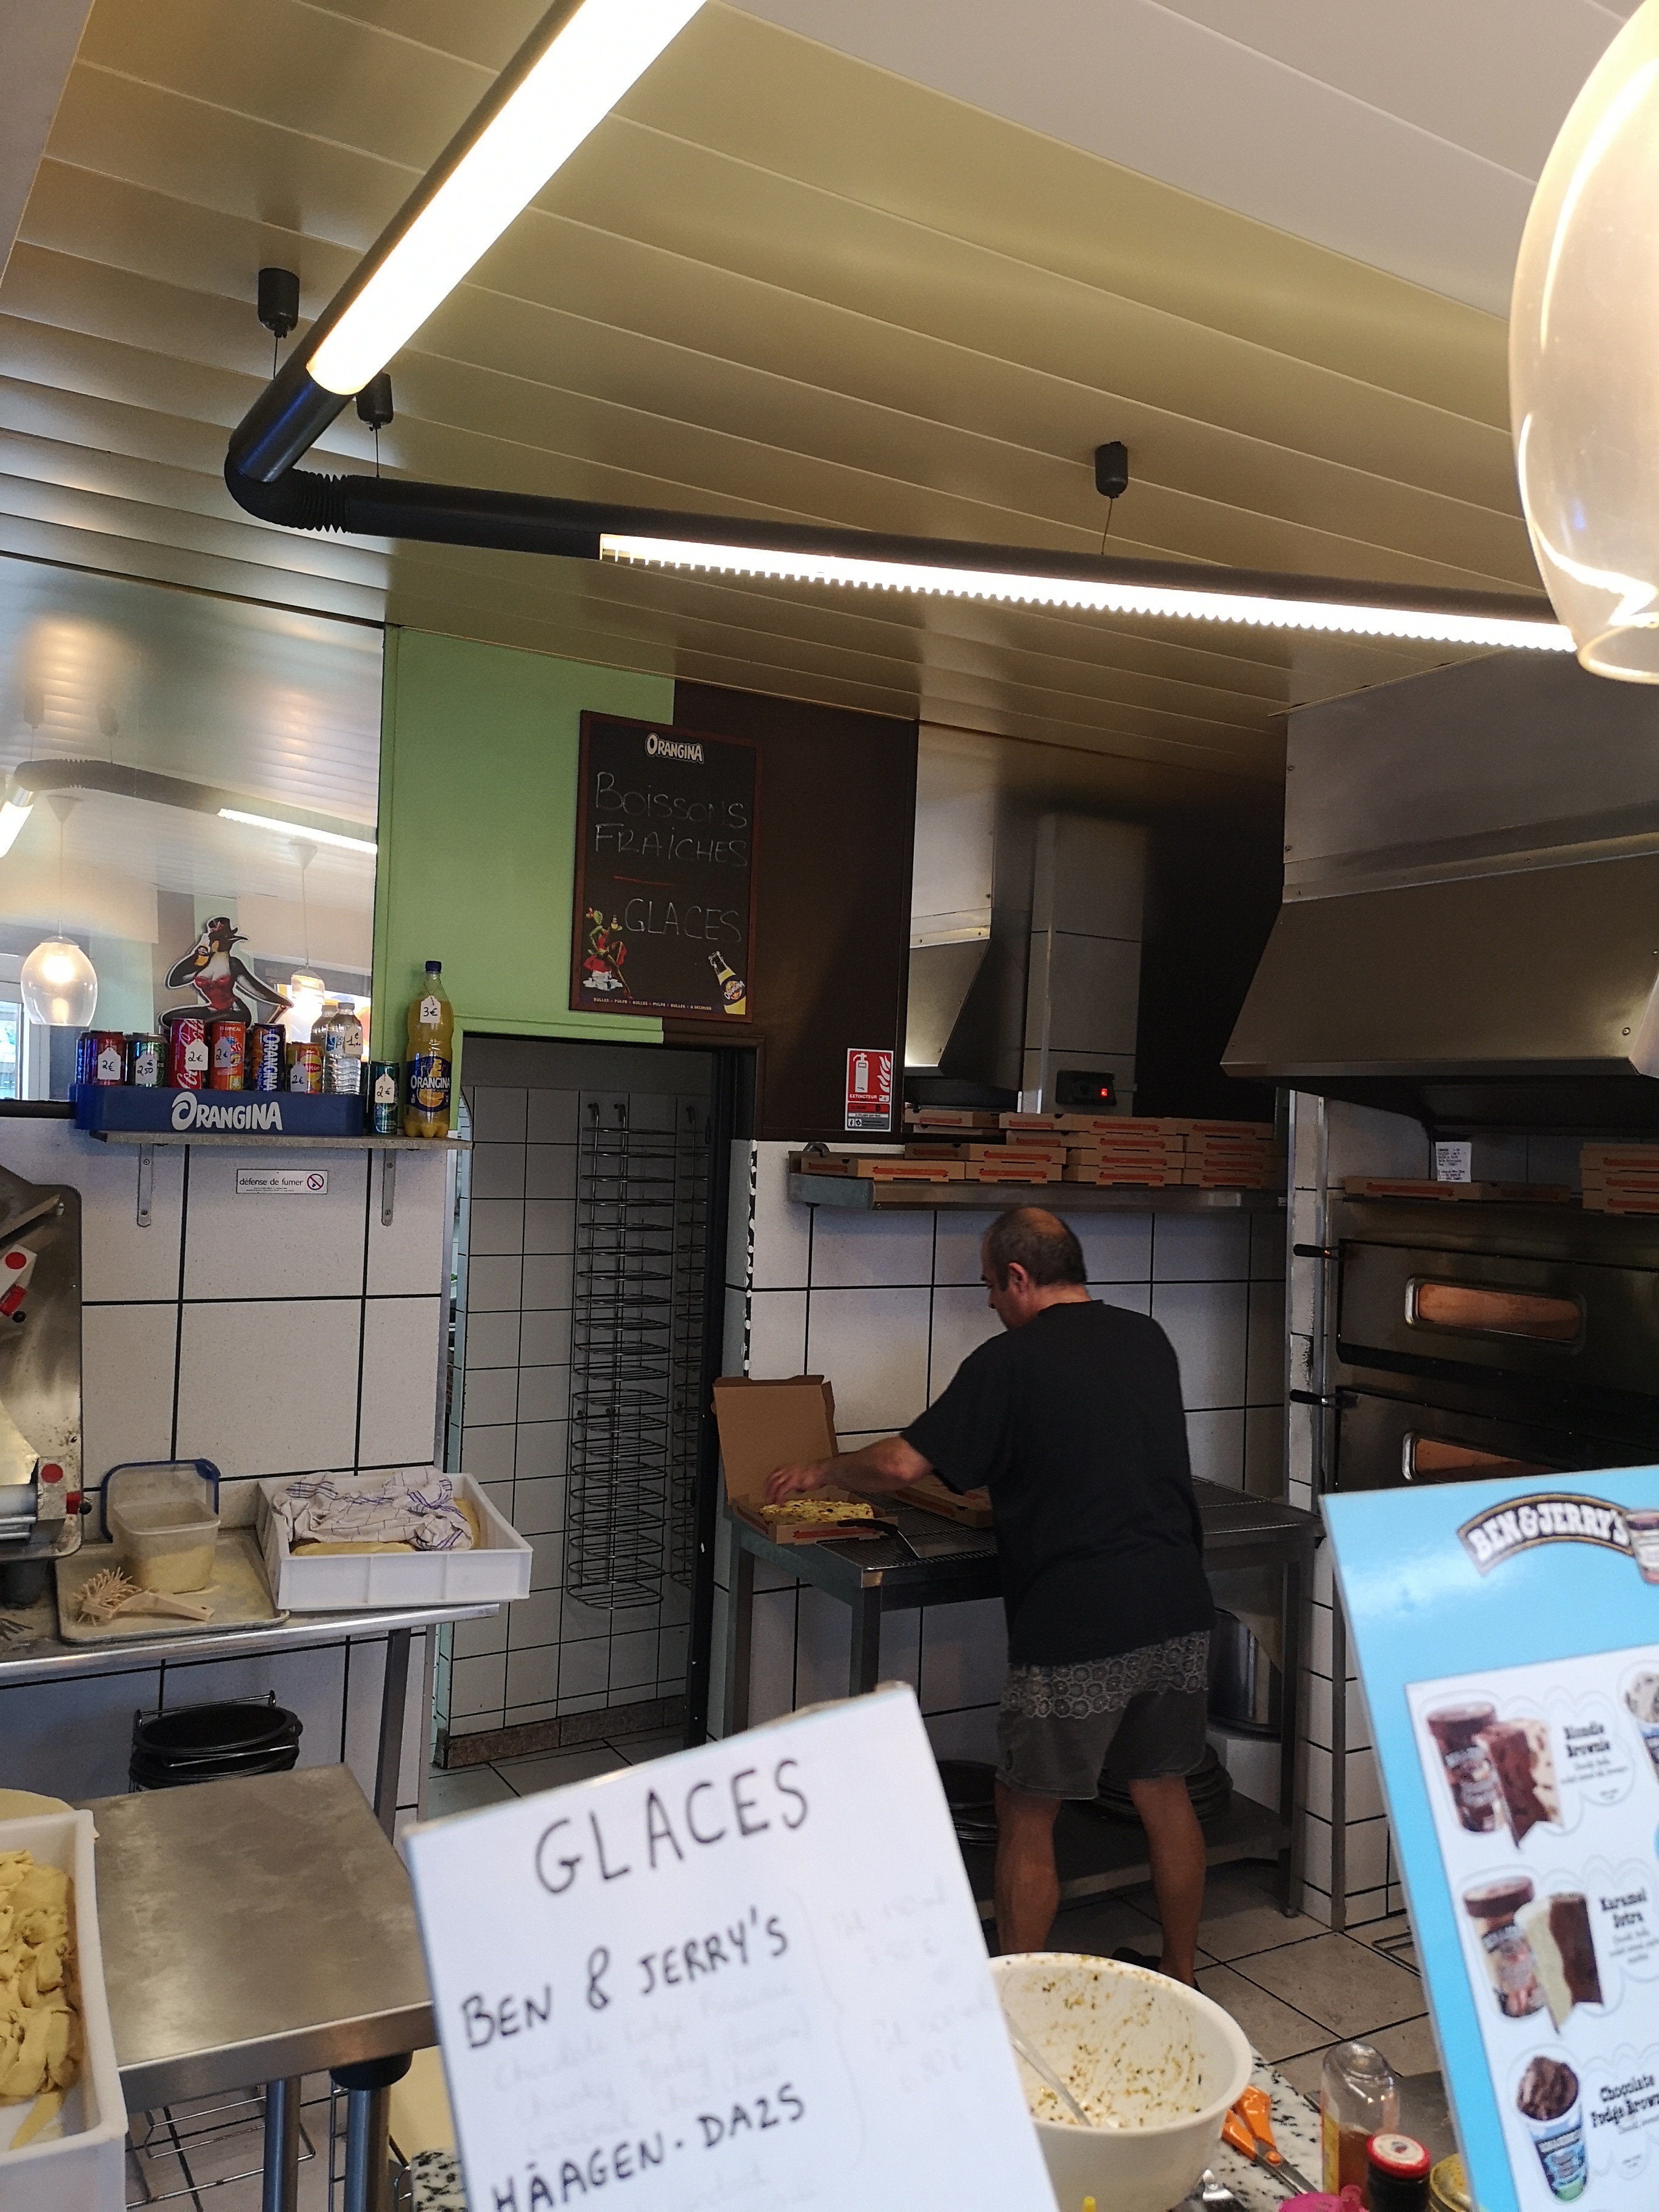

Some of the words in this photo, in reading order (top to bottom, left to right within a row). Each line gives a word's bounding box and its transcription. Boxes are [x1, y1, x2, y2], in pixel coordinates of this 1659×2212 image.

[646, 733, 703, 762] ORANGINA
[625, 897, 742, 942] GLACES
[411, 1074, 451, 1089] ORANGINA
[172, 1091, 283, 1131] ORANGINA
[282, 1178, 304, 1186] fumer
[535, 1757, 810, 1895] GLACES
[461, 1983, 552, 2050] BEN
[639, 1905, 791, 1998] JERRY'S
